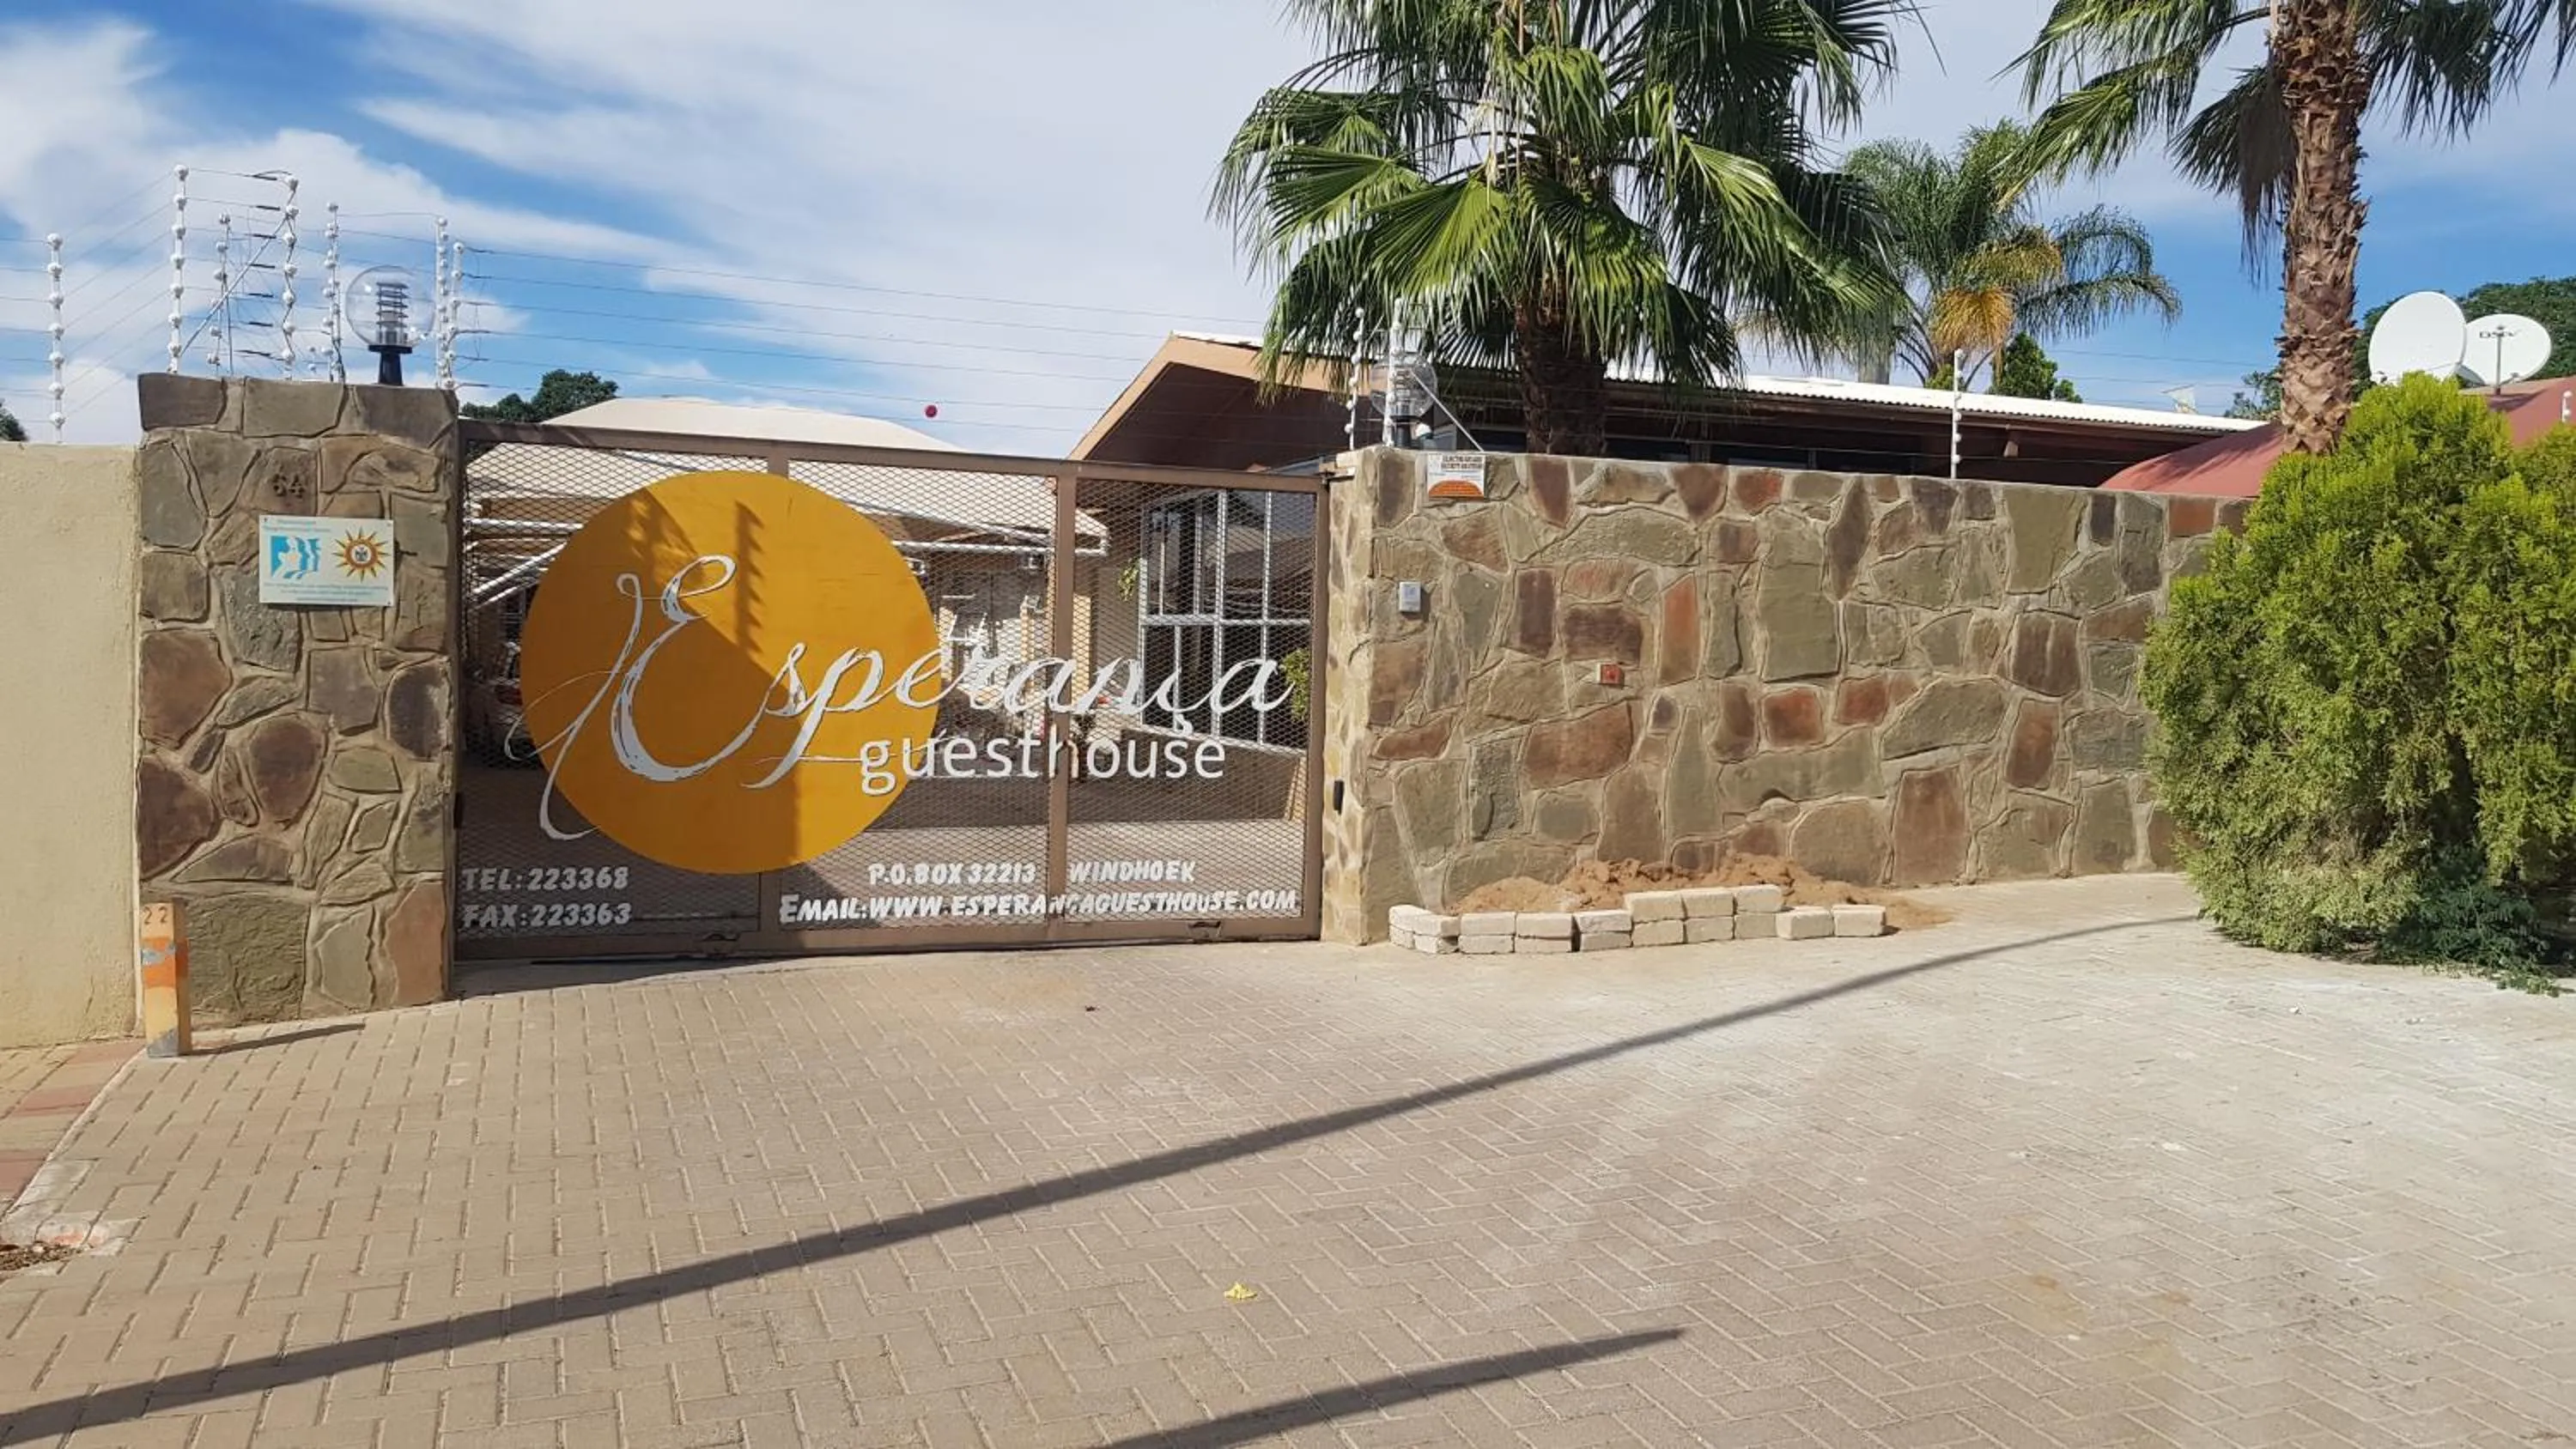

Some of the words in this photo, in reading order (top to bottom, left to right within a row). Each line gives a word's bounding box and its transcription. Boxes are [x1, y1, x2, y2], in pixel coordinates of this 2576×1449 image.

[859, 719, 1226, 796] guesthouse
[967, 862, 1036, 884] 32213
[1069, 860, 1196, 882] WINDHOEK
